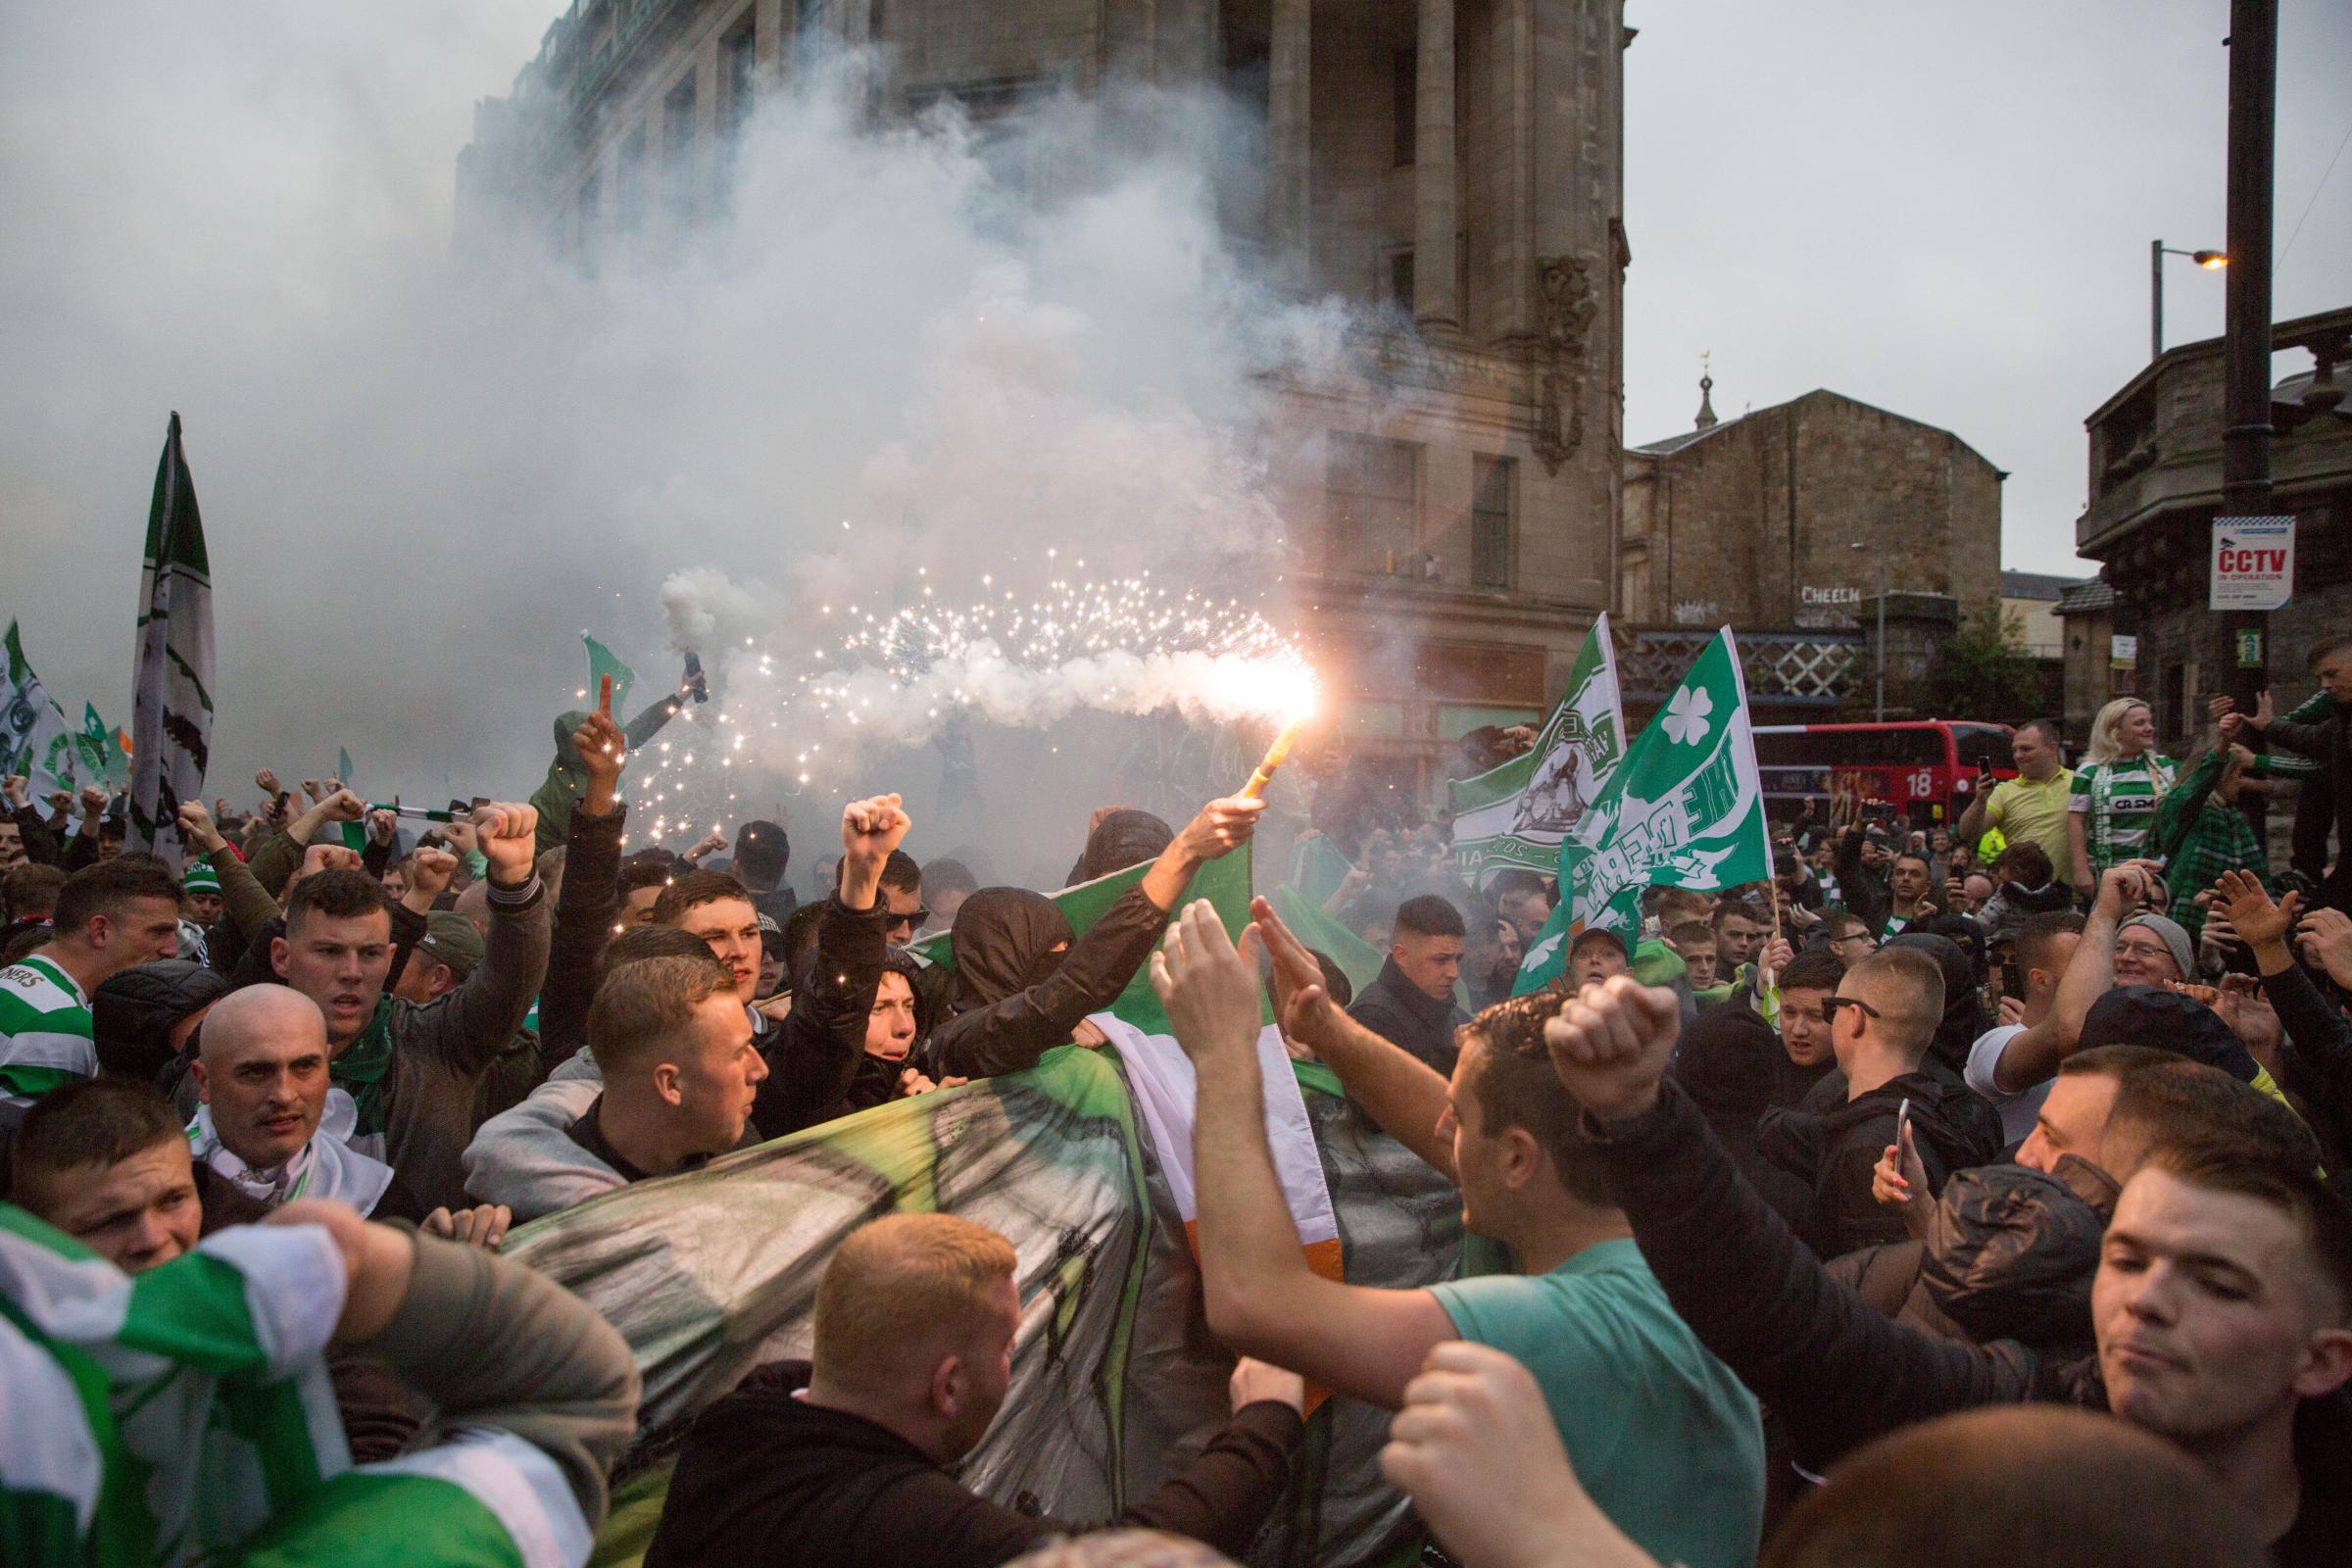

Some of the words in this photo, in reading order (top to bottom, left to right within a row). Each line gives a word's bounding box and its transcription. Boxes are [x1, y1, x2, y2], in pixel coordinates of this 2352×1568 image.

[2218, 549, 2287, 573] CCTV
[1905, 773, 1932, 798] 18
[2134, 798, 2156, 809] SM
